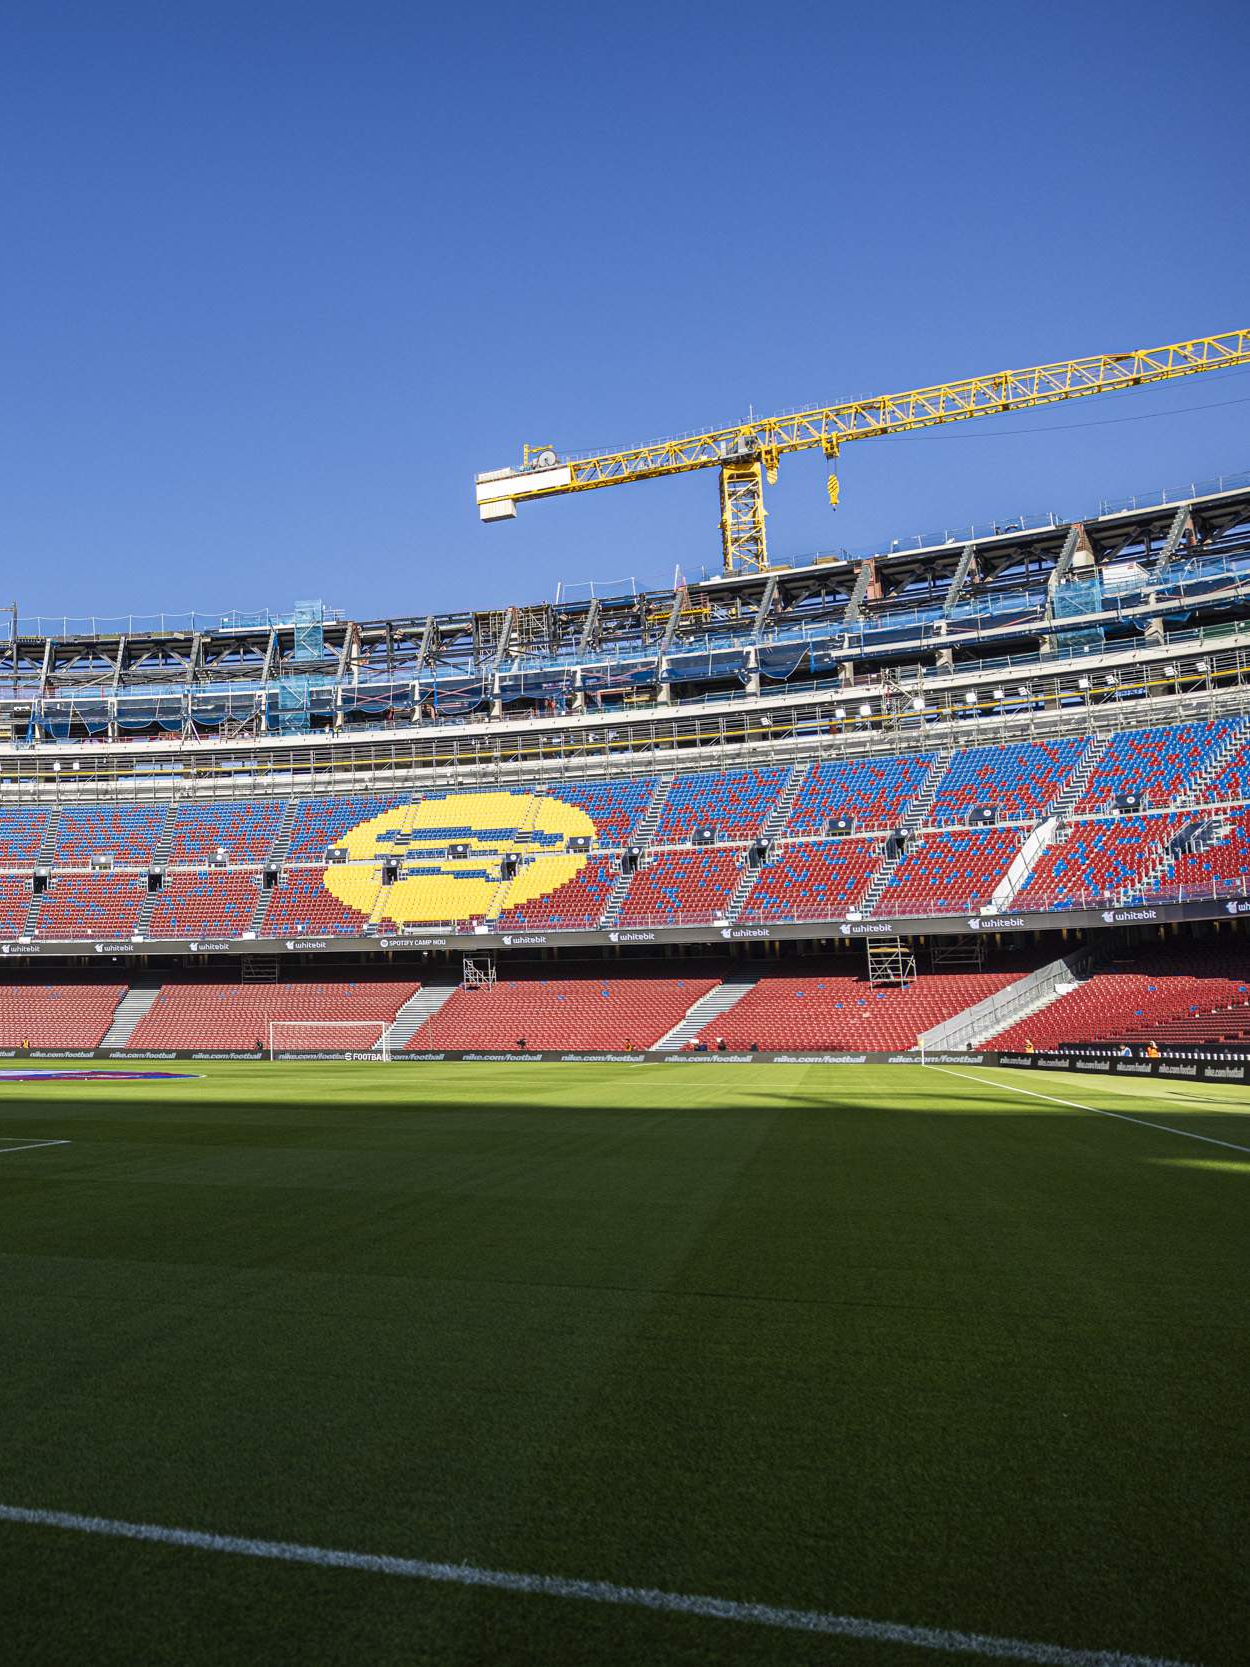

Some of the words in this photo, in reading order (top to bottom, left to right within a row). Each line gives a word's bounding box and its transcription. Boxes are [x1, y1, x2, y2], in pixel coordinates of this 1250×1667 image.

[1115, 910, 1157, 921] whitebit
[981, 918, 1024, 928] whitebit
[852, 923, 892, 933] whitebit
[619, 932, 655, 941] whitebit
[732, 928, 770, 937] whitebit
[432, 938, 446, 946] NOU
[512, 936, 547, 944] whitebit
[10, 944, 40, 953] whitebit
[104, 943, 134, 952] whitebit
[199, 942, 230, 950] whitebit
[295, 941, 327, 949] whitebit
[462, 1053, 543, 1061] nike.com/football
[561, 1054, 645, 1062] nike.com/football
[664, 1055, 753, 1063] nike.com/football
[773, 1055, 866, 1063] nike.com/football
